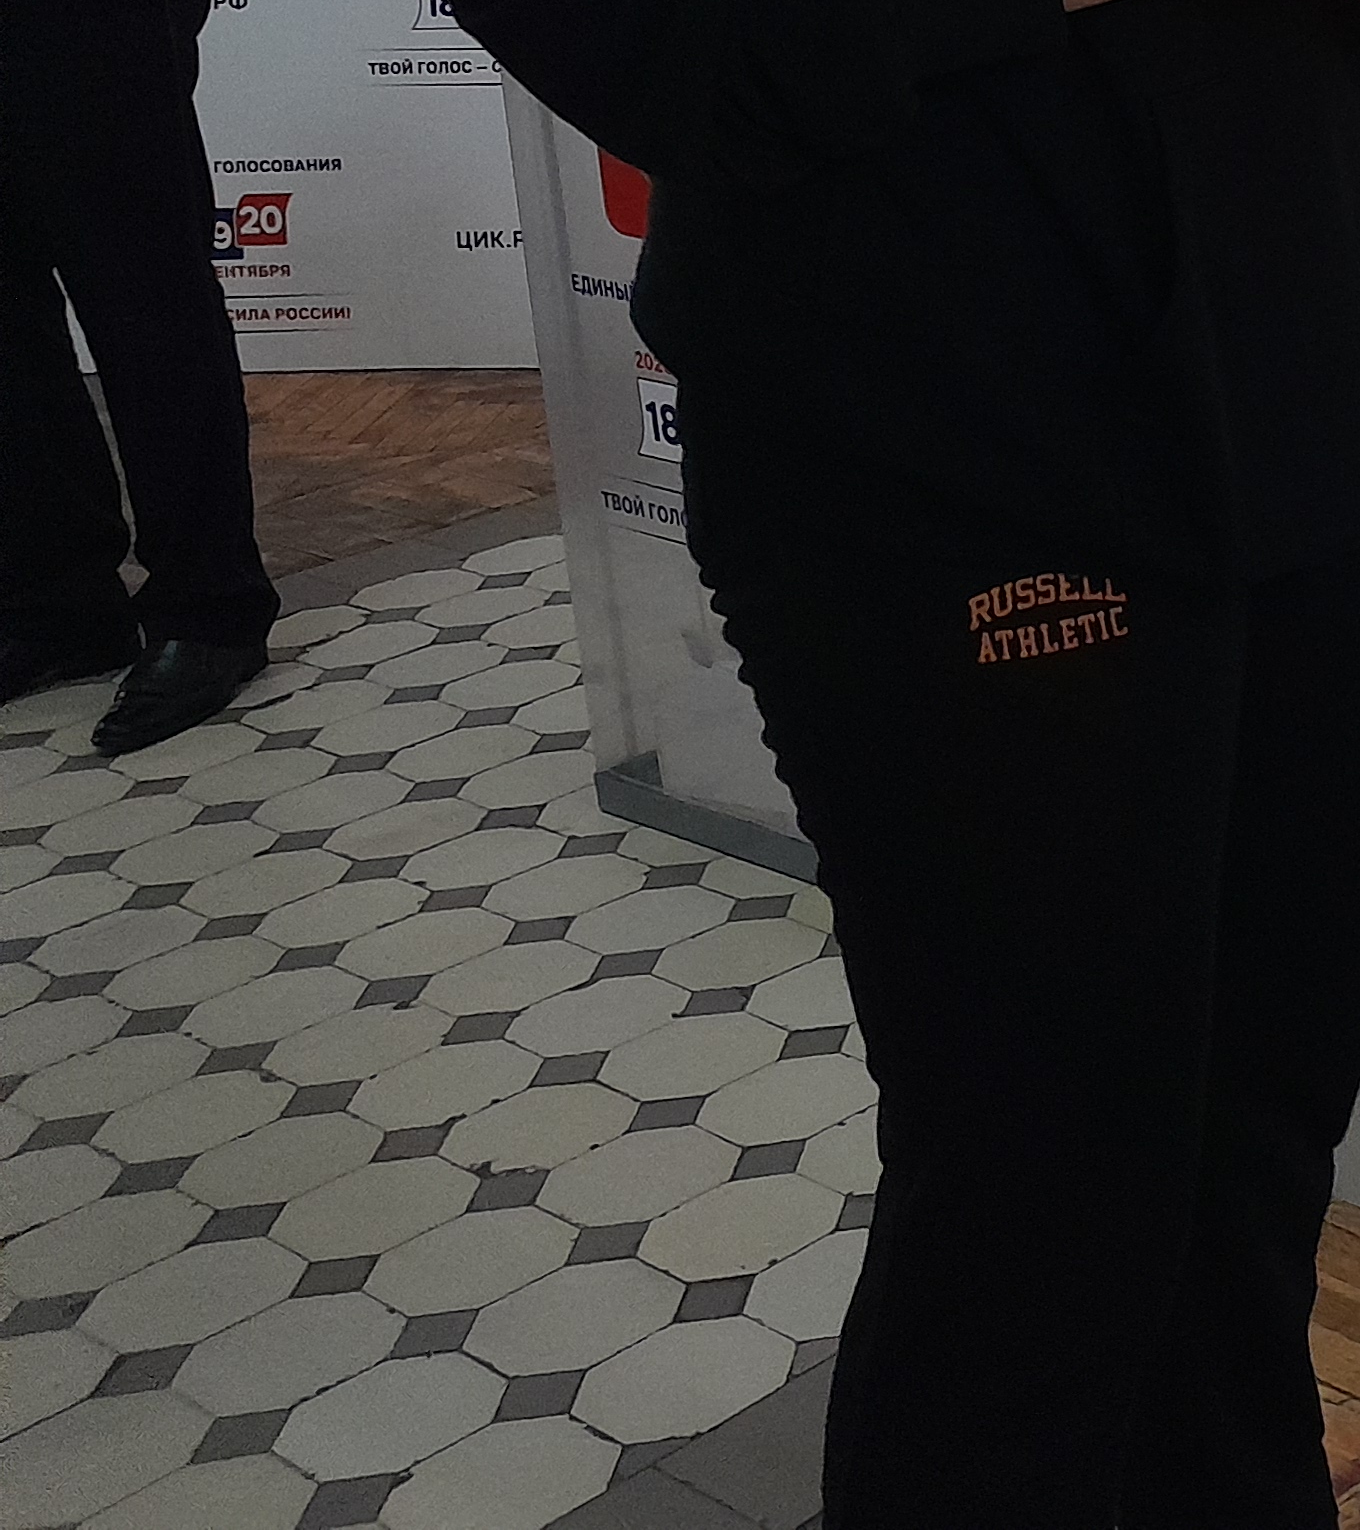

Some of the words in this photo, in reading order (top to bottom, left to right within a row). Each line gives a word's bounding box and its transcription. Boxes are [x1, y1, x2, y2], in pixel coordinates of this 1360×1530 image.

[367, 58, 413, 75] ТВОЙ
[417, 60, 472, 74] ГОЛОС
[213, 158, 342, 173] ГОЛОСОВАНИЯ
[213, 221, 232, 249] 9
[238, 205, 283, 235] 20
[456, 230, 523, 251] ЦИК.Р
[214, 264, 291, 279] ЕНТЯБРЯ
[227, 308, 271, 321] СИЛА
[275, 307, 351, 320] РОССИИ!
[645, 401, 681, 446] 18
[601, 491, 645, 518] ТВОЙ
[649, 502, 686, 527] ГОЛ
[968, 572, 1127, 631] RUSSELL
[977, 605, 1129, 664] ATHLETIC
